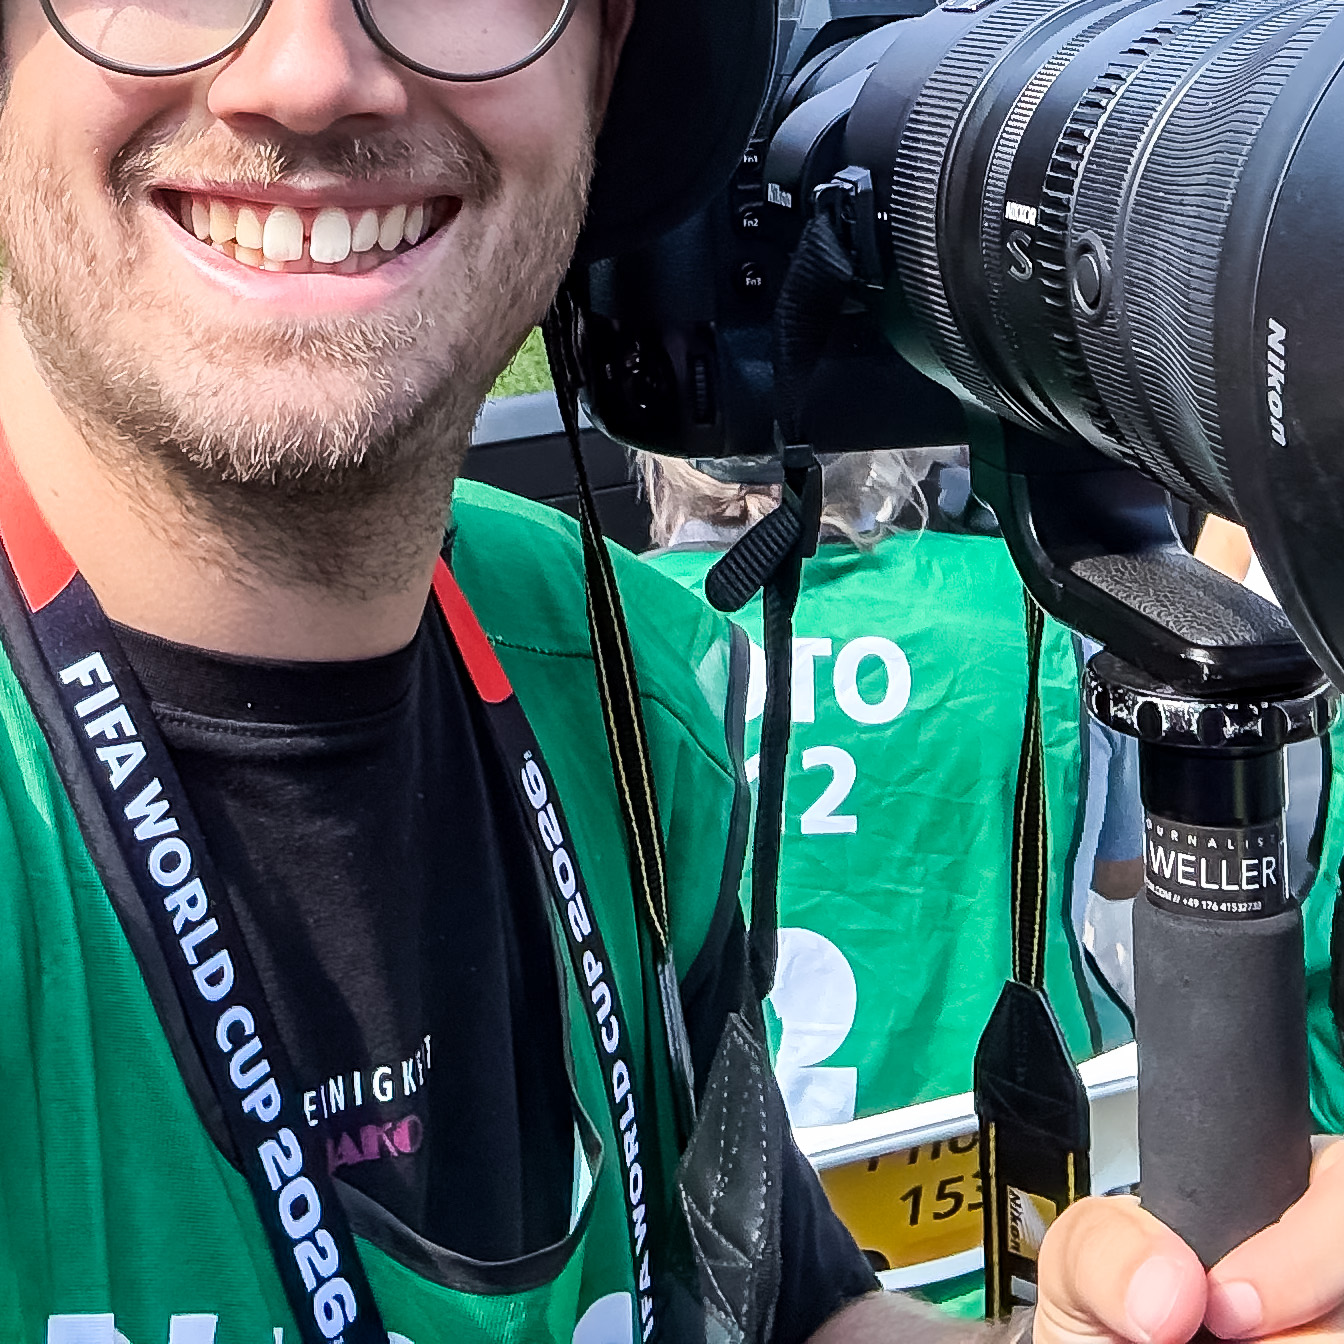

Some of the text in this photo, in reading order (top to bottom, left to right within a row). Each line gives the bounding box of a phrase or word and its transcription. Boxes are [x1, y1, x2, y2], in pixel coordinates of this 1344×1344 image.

[1007, 229, 1033, 282] S
[1267, 317, 1287, 447] Nikon
[521, 758, 593, 944] 2026
[58, 652, 358, 1340] FIFA WORLD CUP 2026
[582, 949, 620, 1054] CUP
[612, 1059, 649, 1257] WORLD
